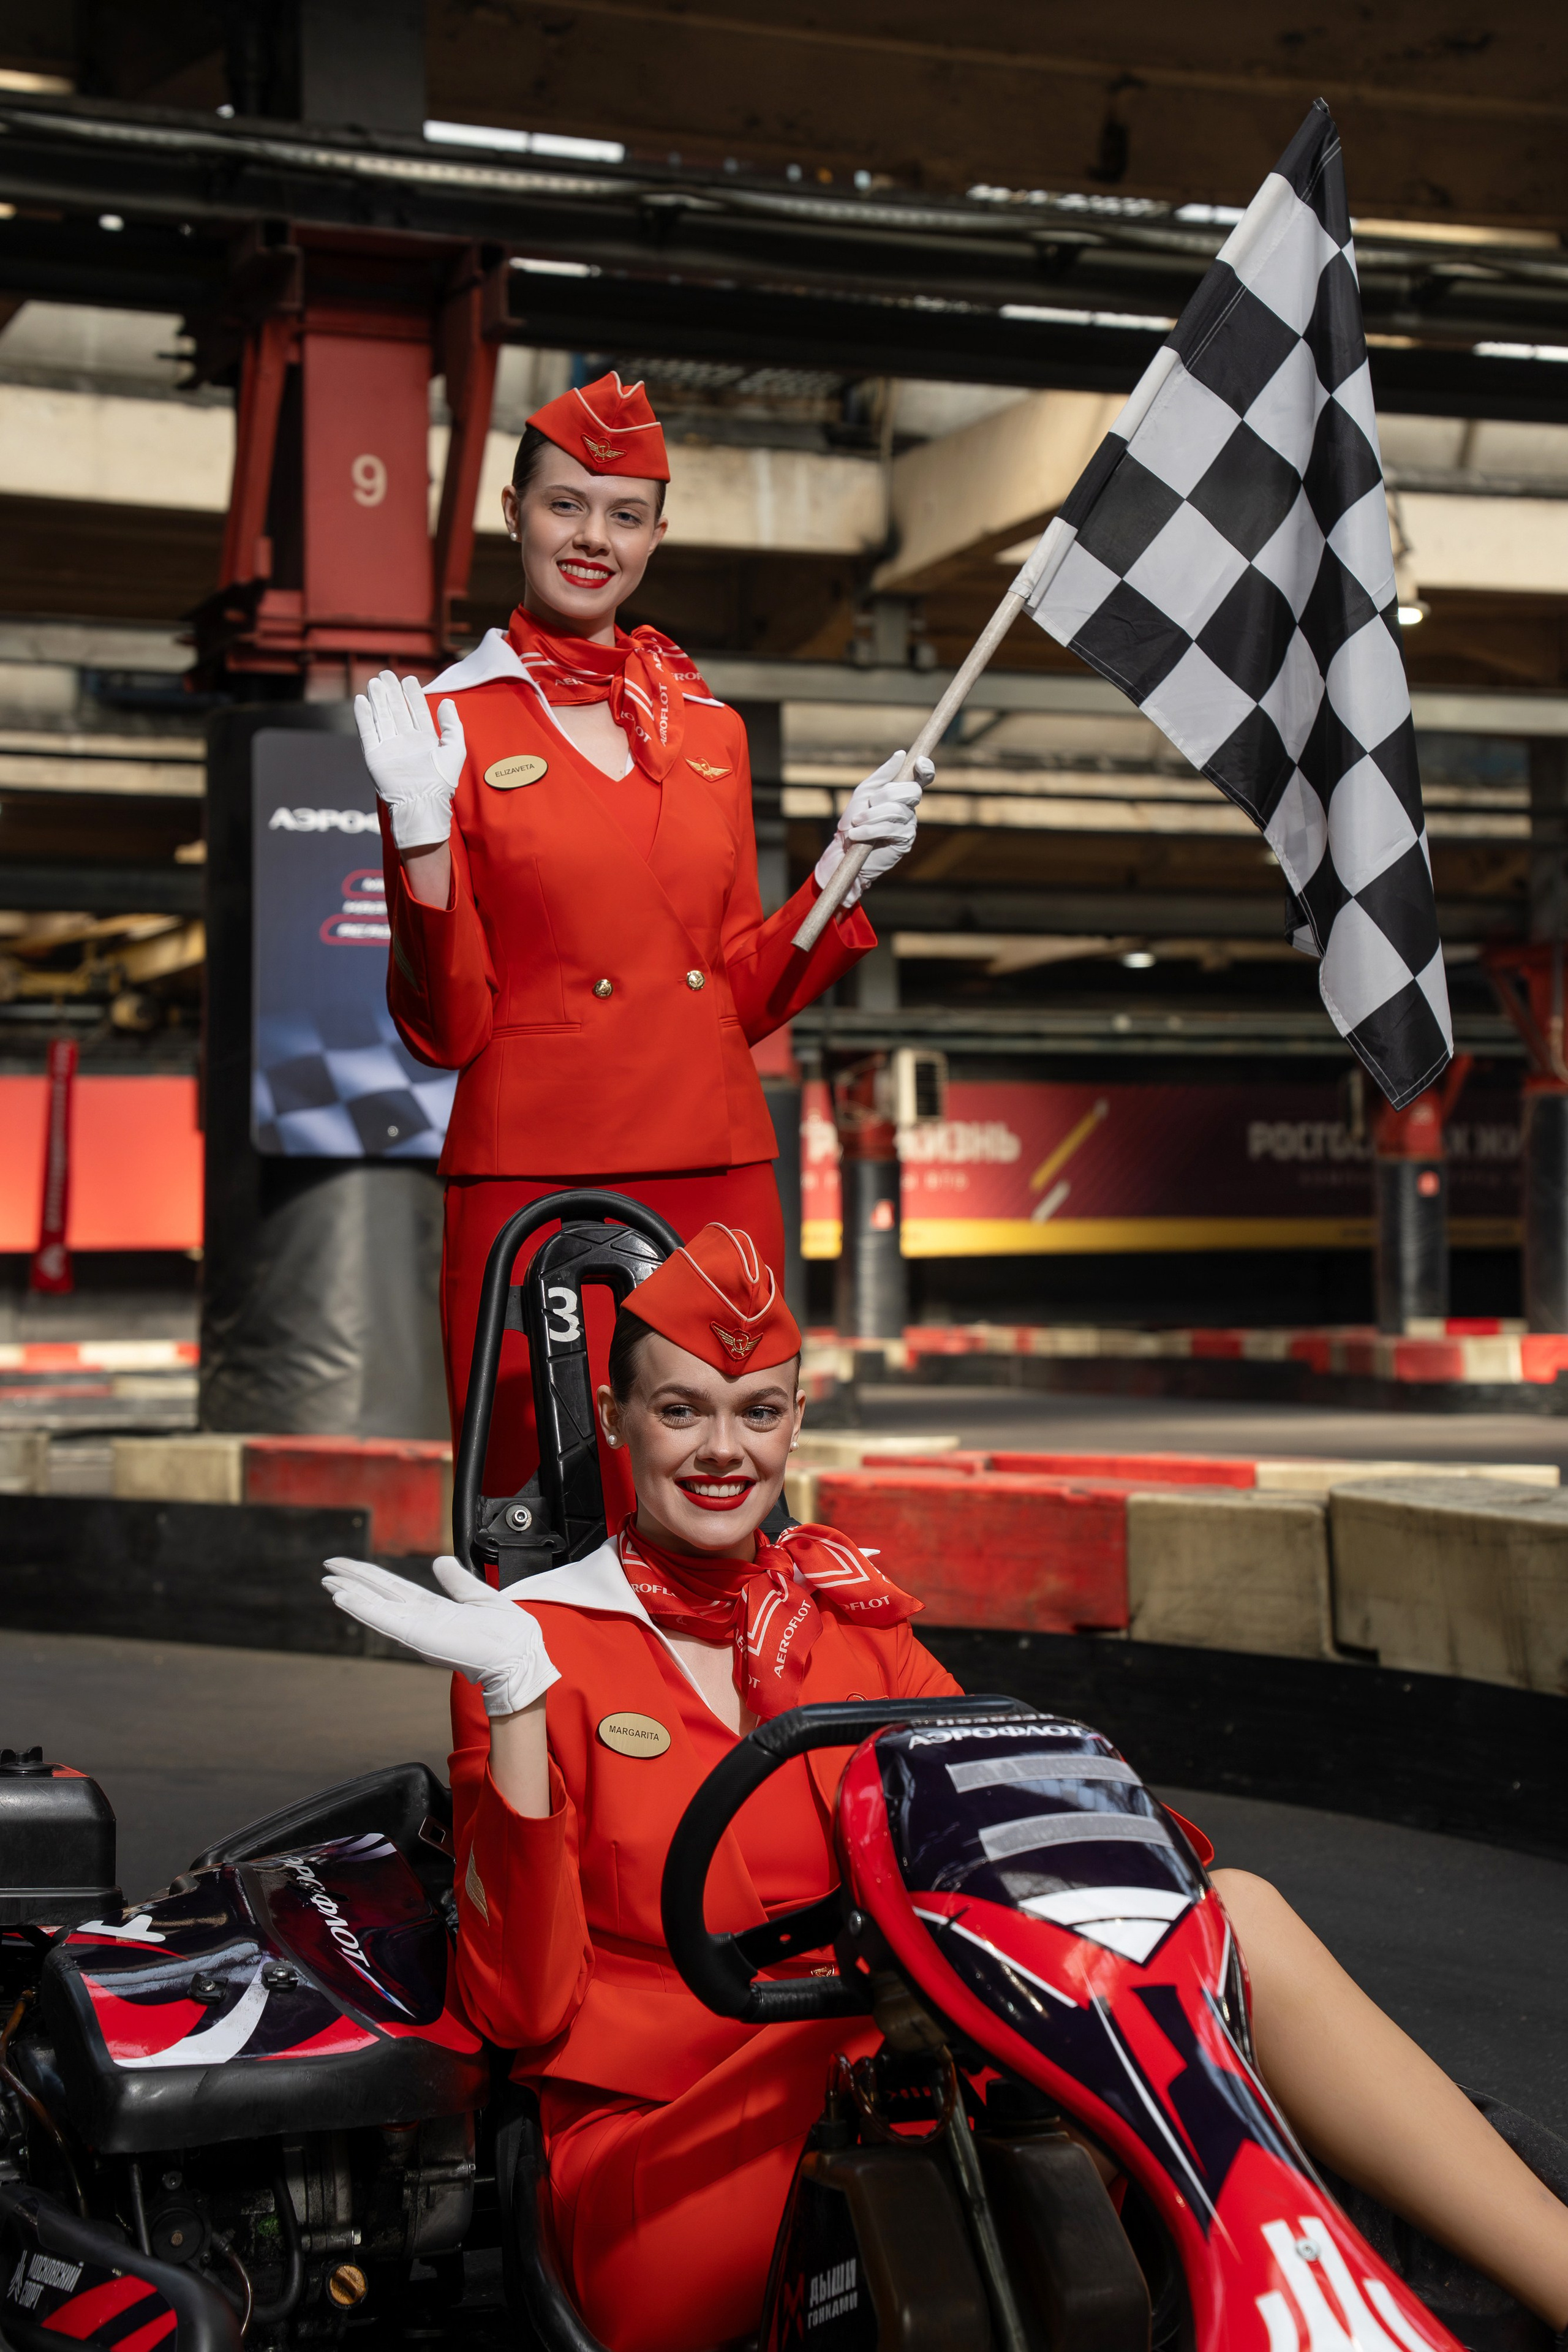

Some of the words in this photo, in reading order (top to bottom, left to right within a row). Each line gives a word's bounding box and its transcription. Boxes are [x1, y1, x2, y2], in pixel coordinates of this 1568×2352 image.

[351, 453, 388, 508] 9
[658, 682, 669, 747] AEROFLOT
[495, 763, 535, 777] ELIZAVETA
[548, 1287, 581, 1342] 3
[774, 1599, 812, 1678] AEROFLOT
[609, 1725, 660, 1741] MARGARITA
[908, 1724, 1084, 1751] АЭРОФЛОТ
[810, 2258, 856, 2309] ДЫШИ
[807, 2291, 858, 2330] ГОНКАМИ
